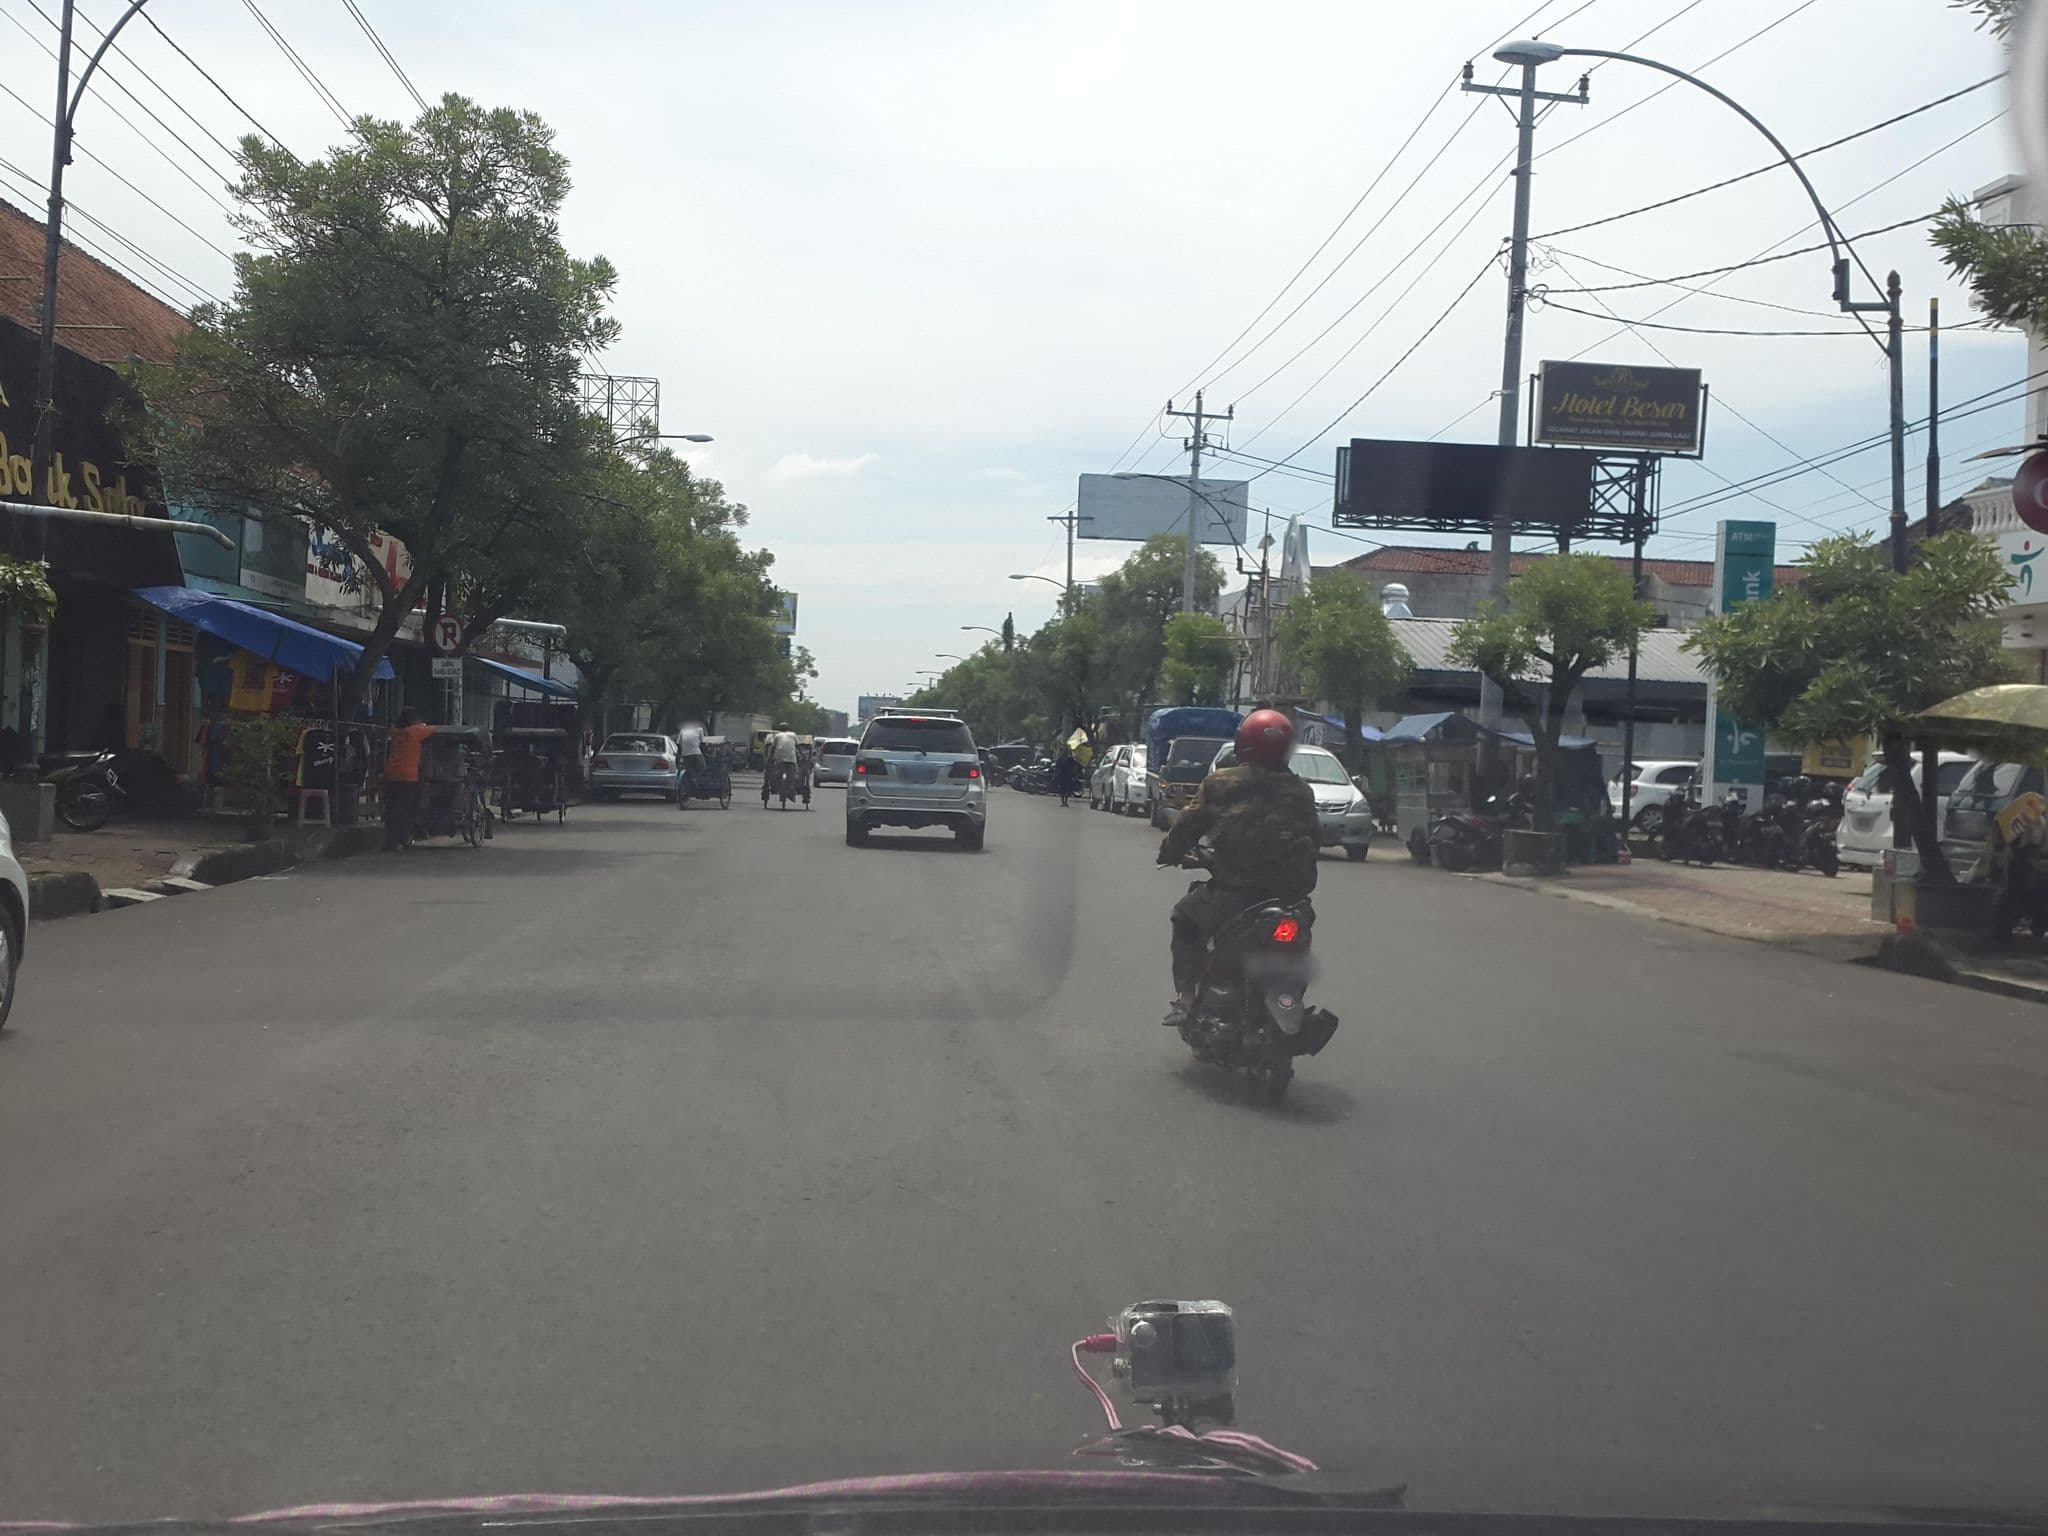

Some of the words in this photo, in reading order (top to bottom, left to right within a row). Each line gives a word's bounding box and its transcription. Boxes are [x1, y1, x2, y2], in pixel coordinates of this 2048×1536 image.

[1552, 392, 1616, 415] Hotel
[1621, 396, 1686, 419] Besar
[1731, 532, 1753, 542] ATM
